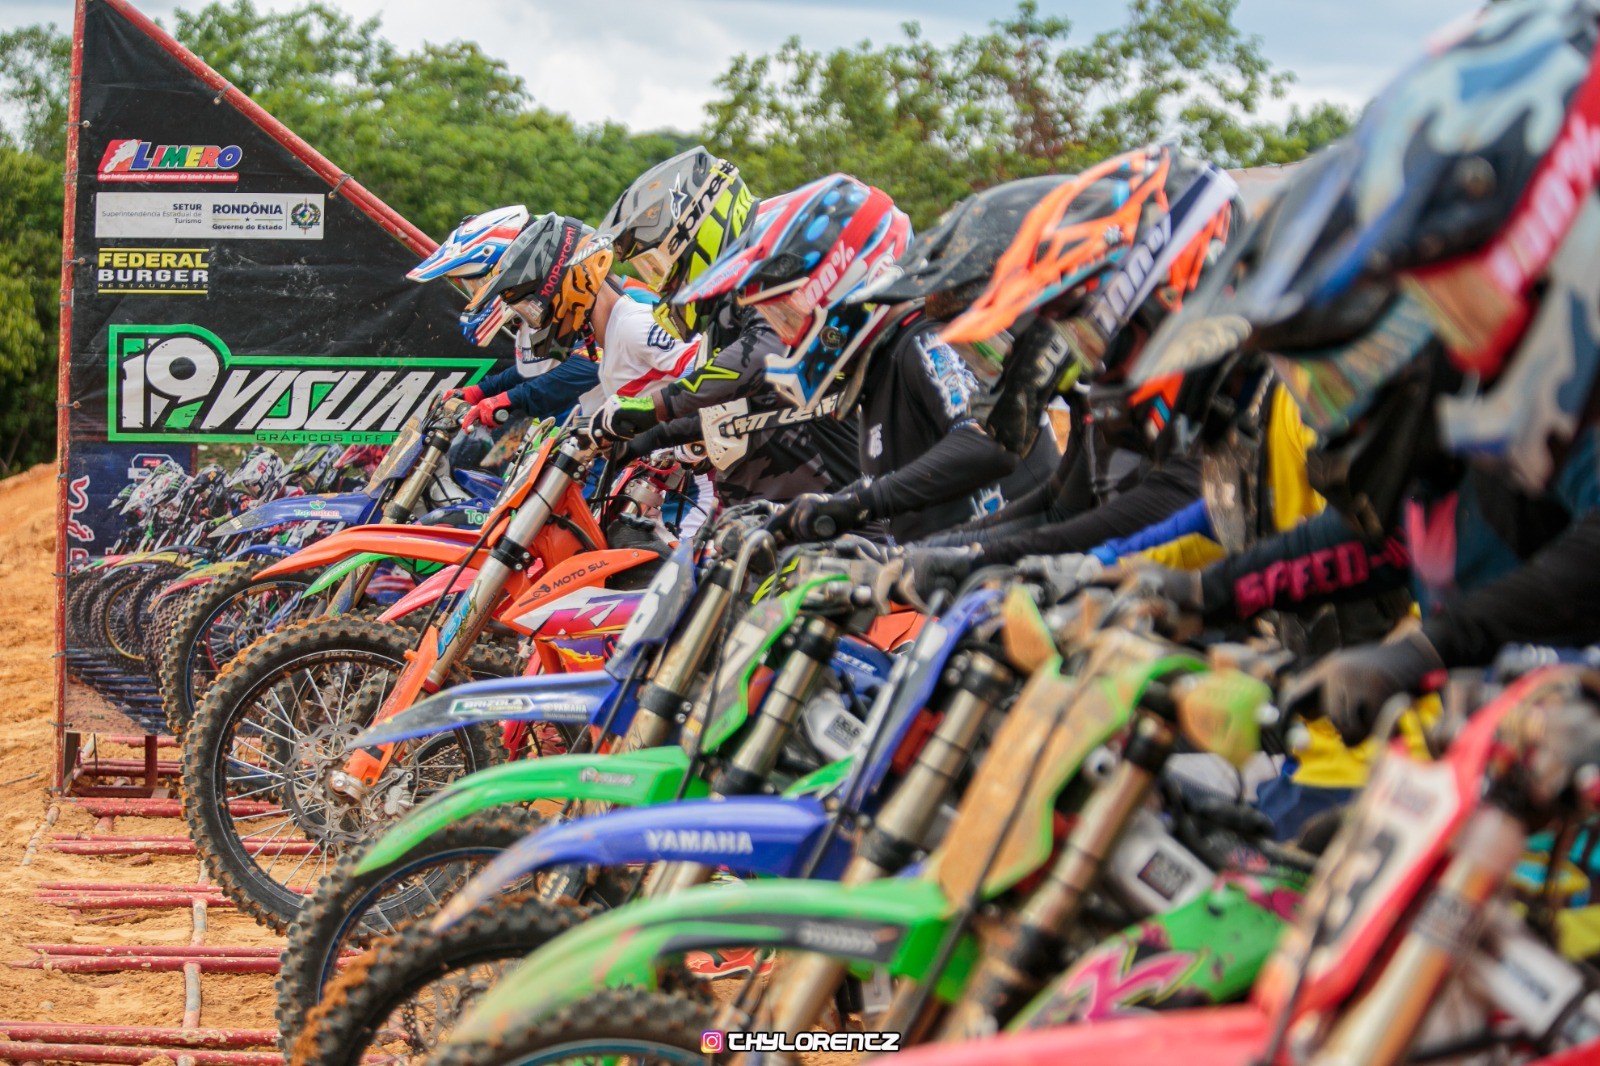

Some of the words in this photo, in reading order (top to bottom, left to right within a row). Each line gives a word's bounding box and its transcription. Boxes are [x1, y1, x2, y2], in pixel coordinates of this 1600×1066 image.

[102, 210, 161, 218] Superintendência
[173, 203, 202, 211] SETUR
[212, 201, 283, 215] RONDÔNIA
[98, 252, 209, 269] FEDERAL
[541, 226, 577, 297] 100Percent
[98, 269, 209, 282] BURGER
[790, 239, 855, 315] 100%
[122, 337, 220, 430] 19
[256, 430, 344, 443] GRÁFICOS
[351, 434, 384, 443] OFF
[552, 568, 587, 590] MOTO
[588, 559, 610, 573] SUL
[553, 703, 587, 713] YAMAHA
[644, 829, 754, 854] YAMAHA
